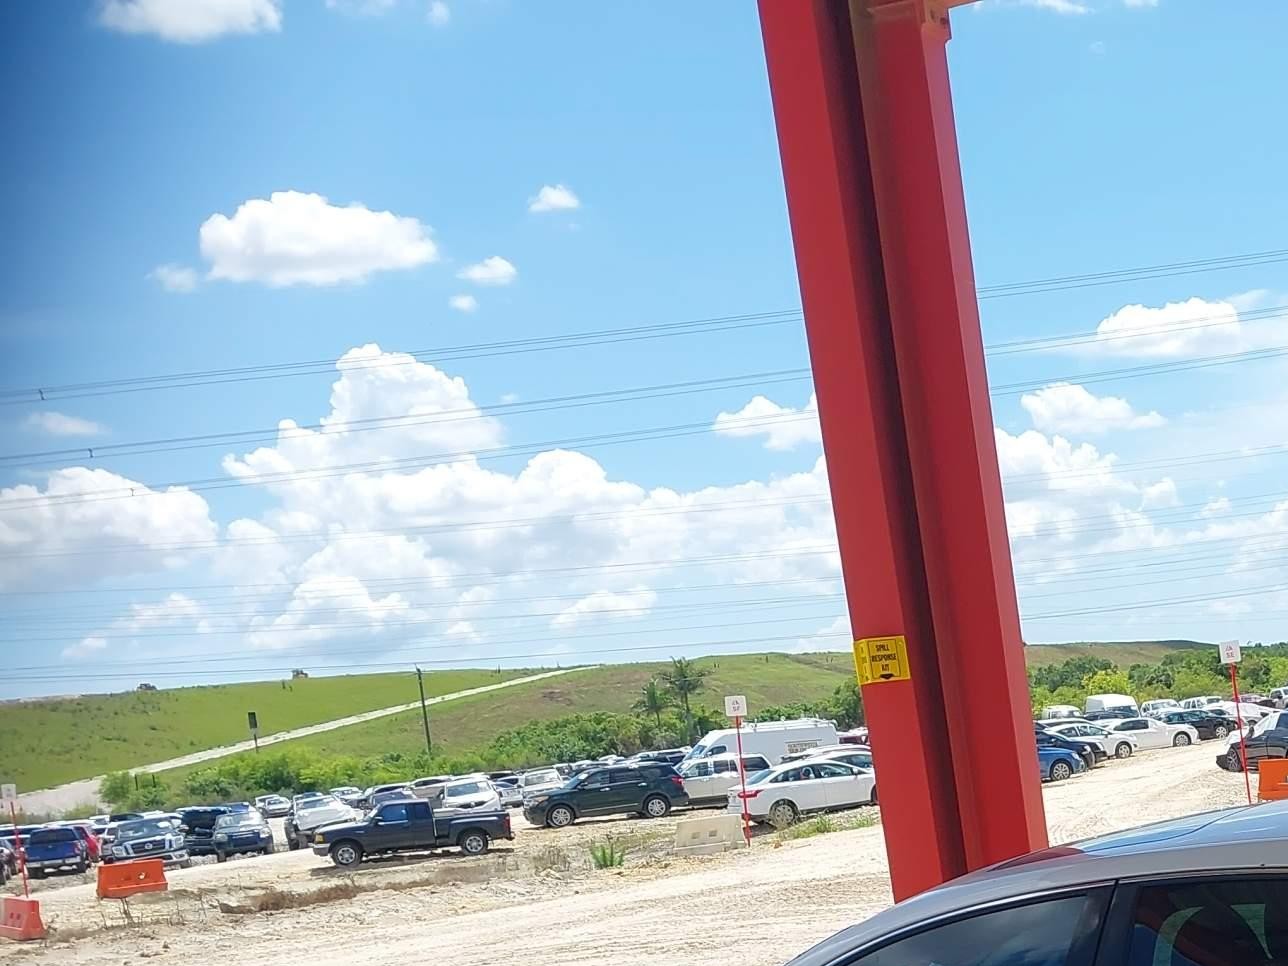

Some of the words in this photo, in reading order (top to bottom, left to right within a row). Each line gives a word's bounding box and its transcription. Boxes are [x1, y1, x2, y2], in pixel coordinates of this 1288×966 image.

[875, 644, 890, 652] SPILL
[871, 654, 898, 663] RESPONSE
[881, 664, 891, 673] KIT
